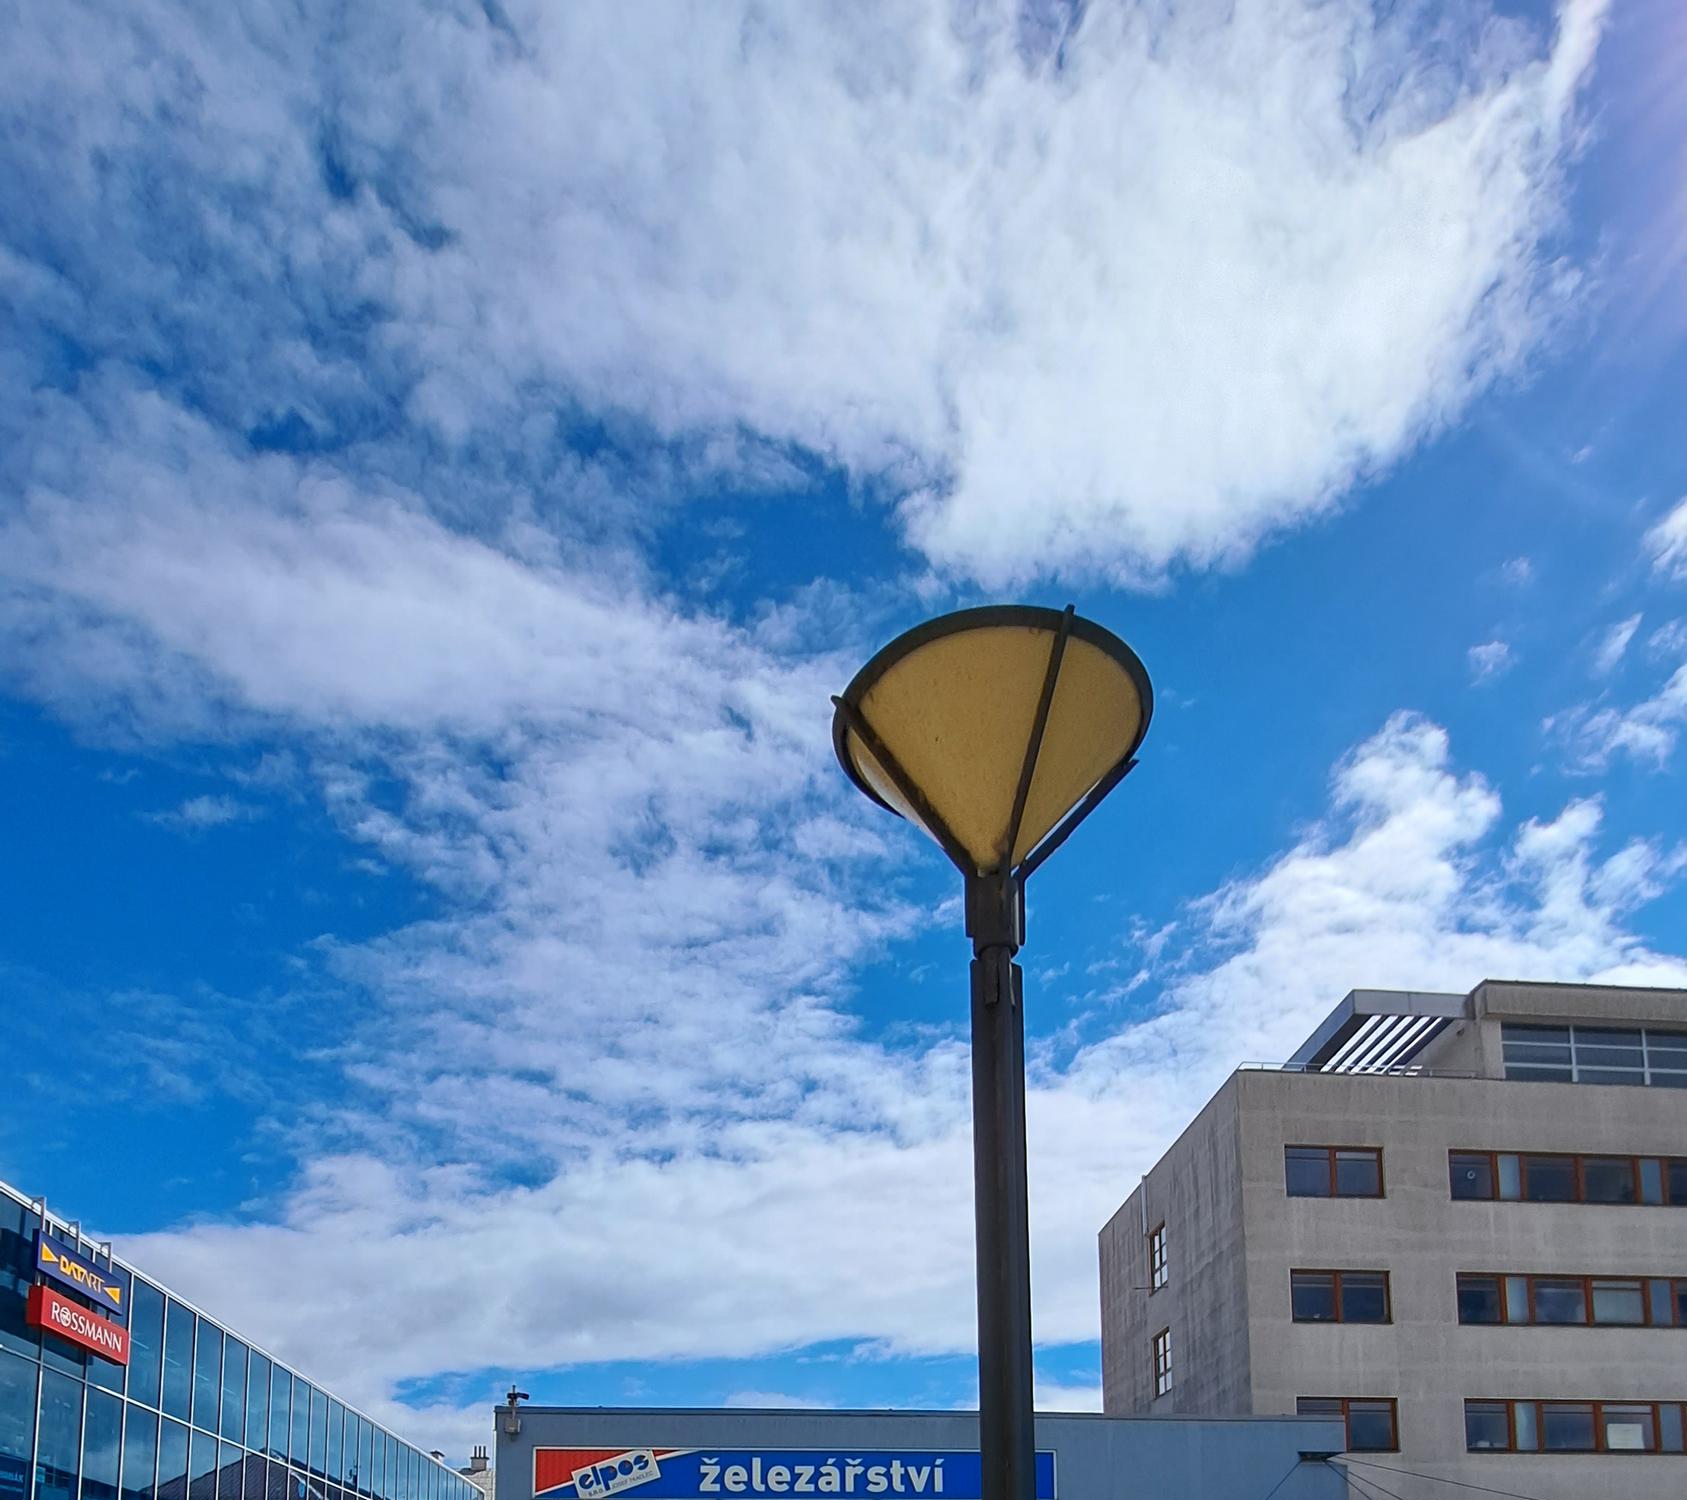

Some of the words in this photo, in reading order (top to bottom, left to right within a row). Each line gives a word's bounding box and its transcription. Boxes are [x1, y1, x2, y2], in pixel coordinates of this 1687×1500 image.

[60, 1255, 105, 1293] DATART
[51, 1301, 122, 1353] ROSSMANN
[579, 1454, 649, 1491] elpos
[699, 1457, 944, 1492] železářství
